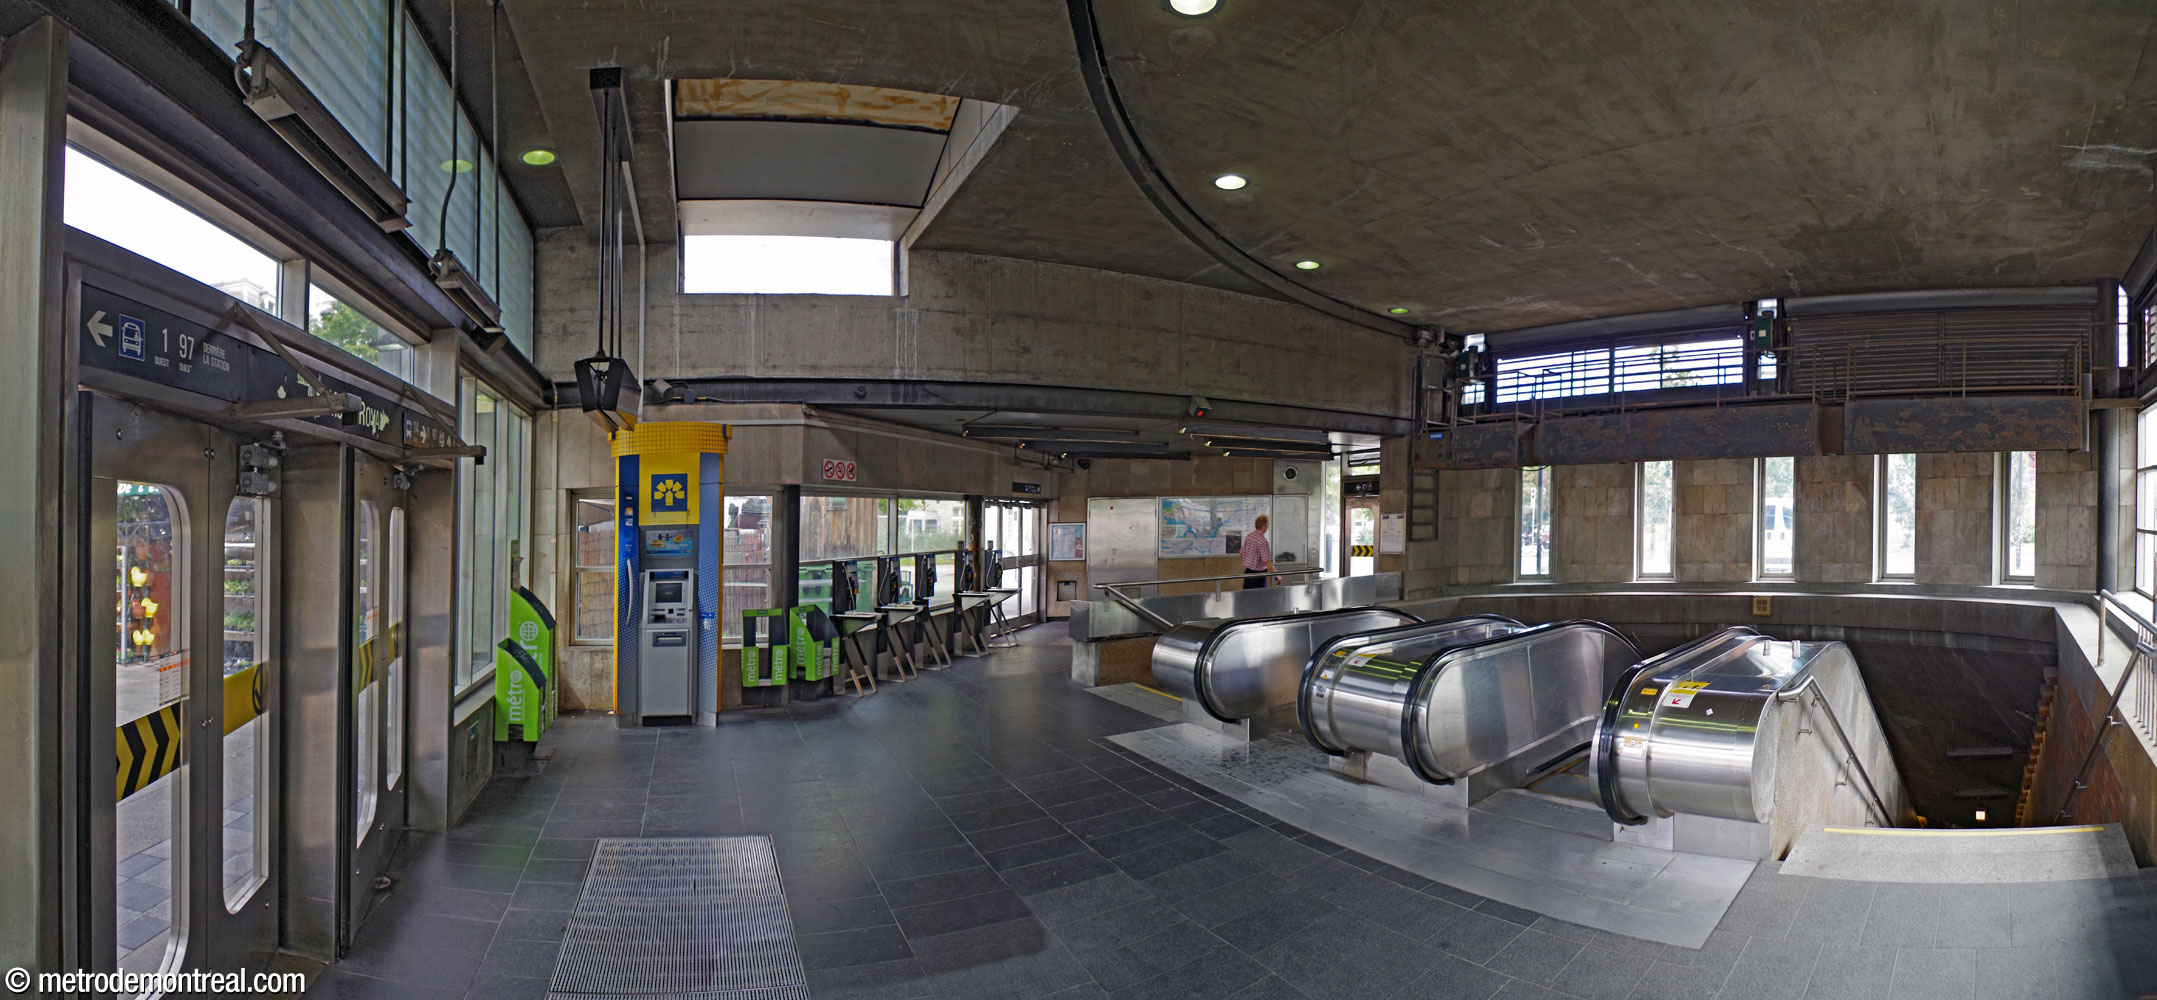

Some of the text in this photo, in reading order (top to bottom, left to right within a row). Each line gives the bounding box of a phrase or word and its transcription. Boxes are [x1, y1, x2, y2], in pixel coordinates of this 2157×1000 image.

[162, 328, 195, 360] 1 97
[154, 356, 170, 367] OUEST
[203, 354, 230, 372] LA STATION
[795, 627, 806, 665] métro
[746, 649, 757, 682] métro
[773, 647, 784, 681] métro
[507, 670, 524, 721] métro
